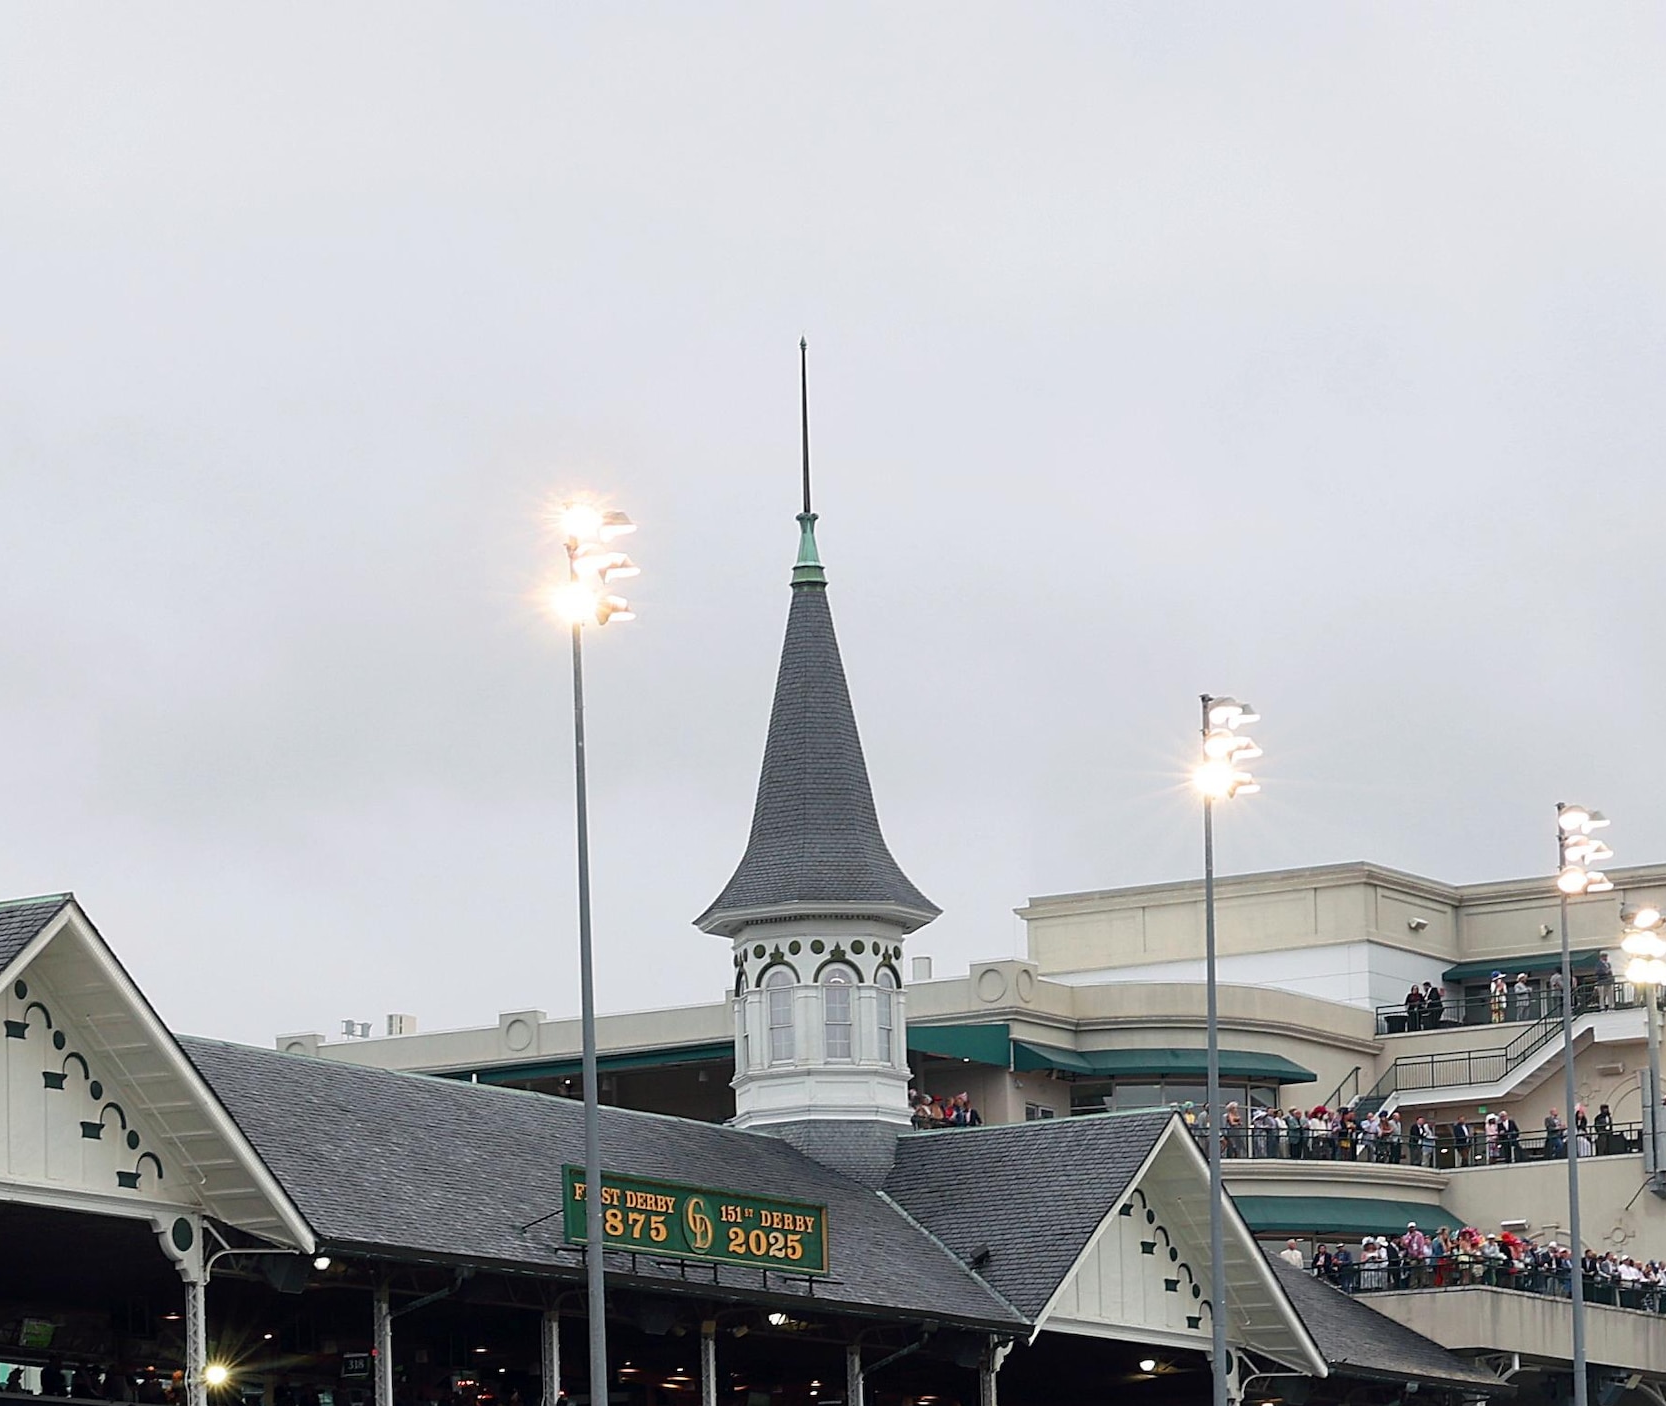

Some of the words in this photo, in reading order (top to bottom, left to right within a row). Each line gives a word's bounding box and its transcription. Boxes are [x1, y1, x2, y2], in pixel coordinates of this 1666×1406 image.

[574, 1183, 620, 1205] FST
[625, 1190, 676, 1214] DERBY
[604, 1208, 668, 1242] 875
[760, 1210, 815, 1233] DERBY
[728, 1227, 803, 1260] 2025
